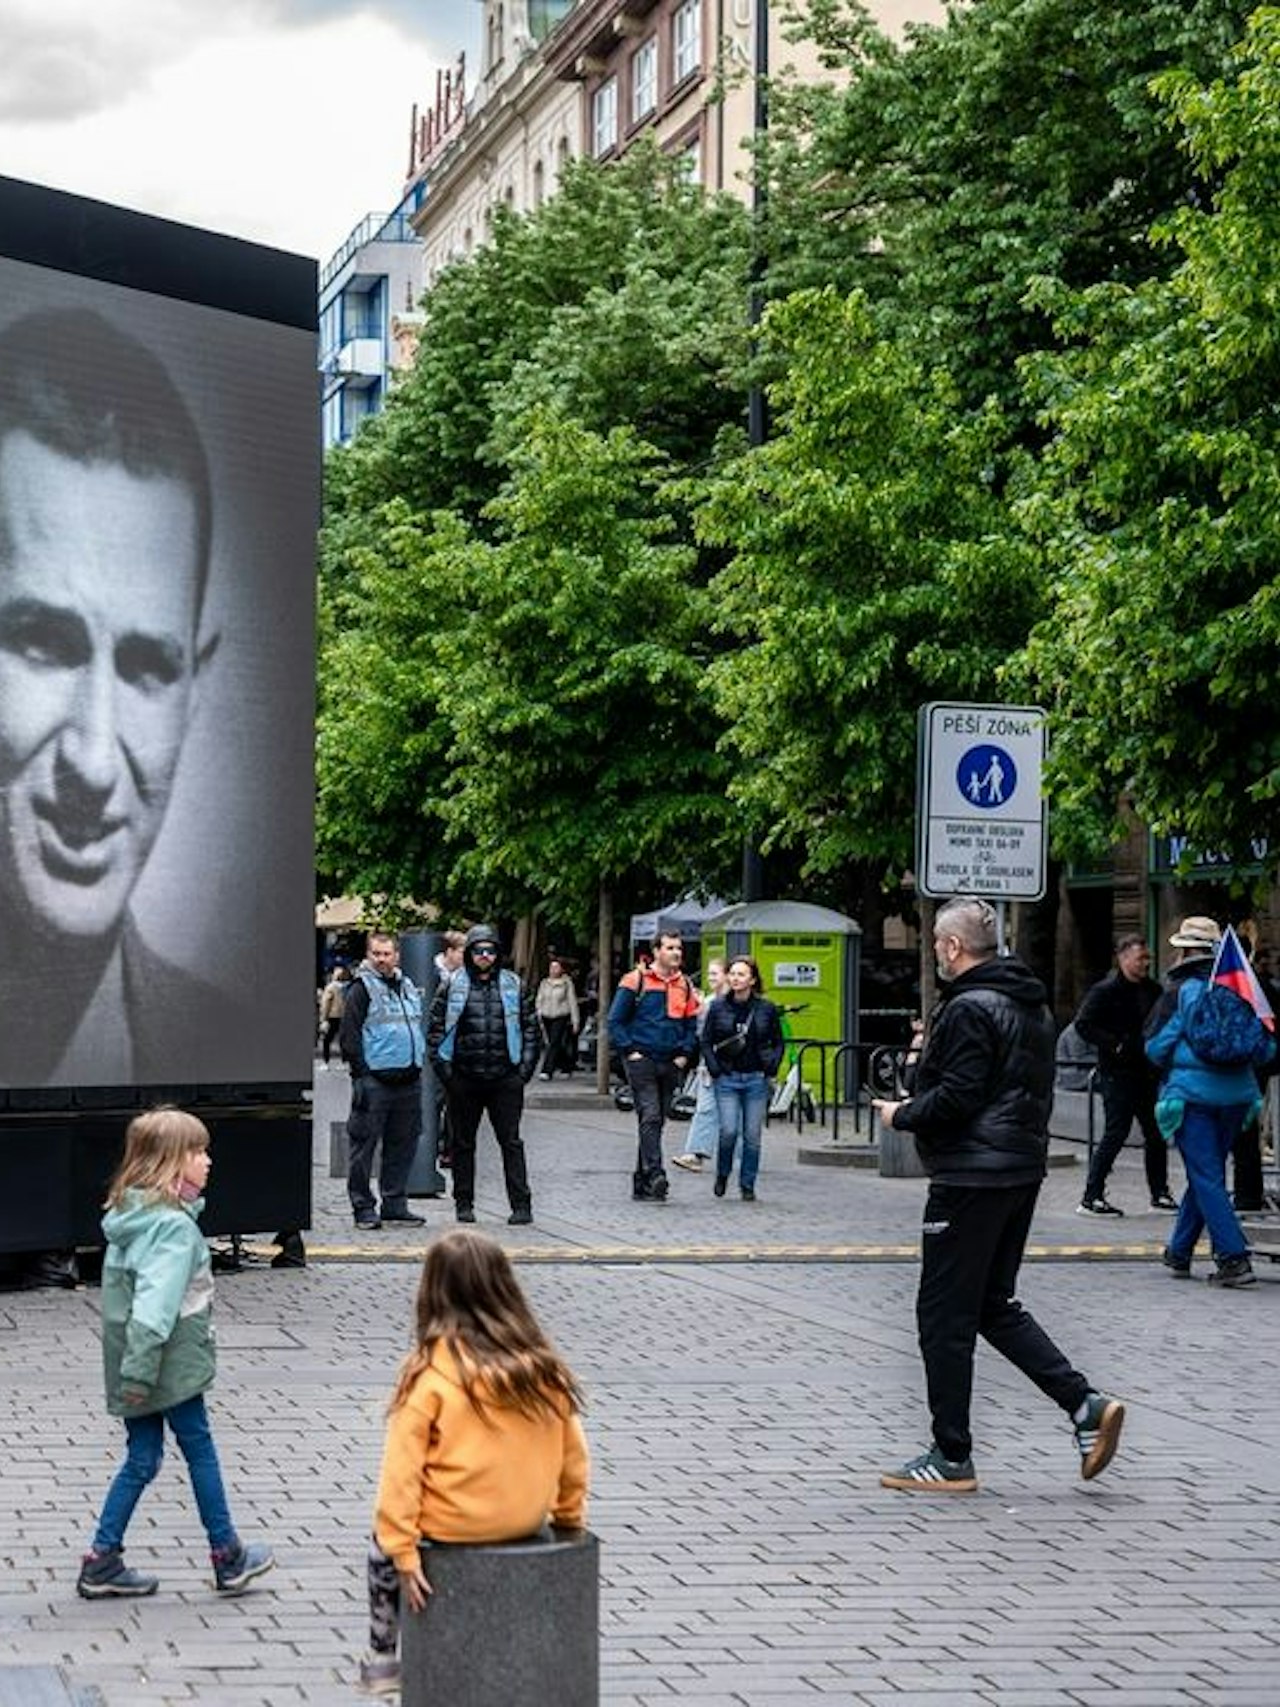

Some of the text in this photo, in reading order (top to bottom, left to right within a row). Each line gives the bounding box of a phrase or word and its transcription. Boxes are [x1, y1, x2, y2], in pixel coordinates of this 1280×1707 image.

[943, 714, 1032, 736] PĚŠÍ ZÓNA
[949, 838, 972, 848] MIMO
[975, 838, 993, 848] TAXI
[972, 865, 982, 875] SE
[986, 866, 1034, 877] SOUHLASEM
[957, 876, 970, 888] MČ
[974, 879, 1002, 889] PRAHA
